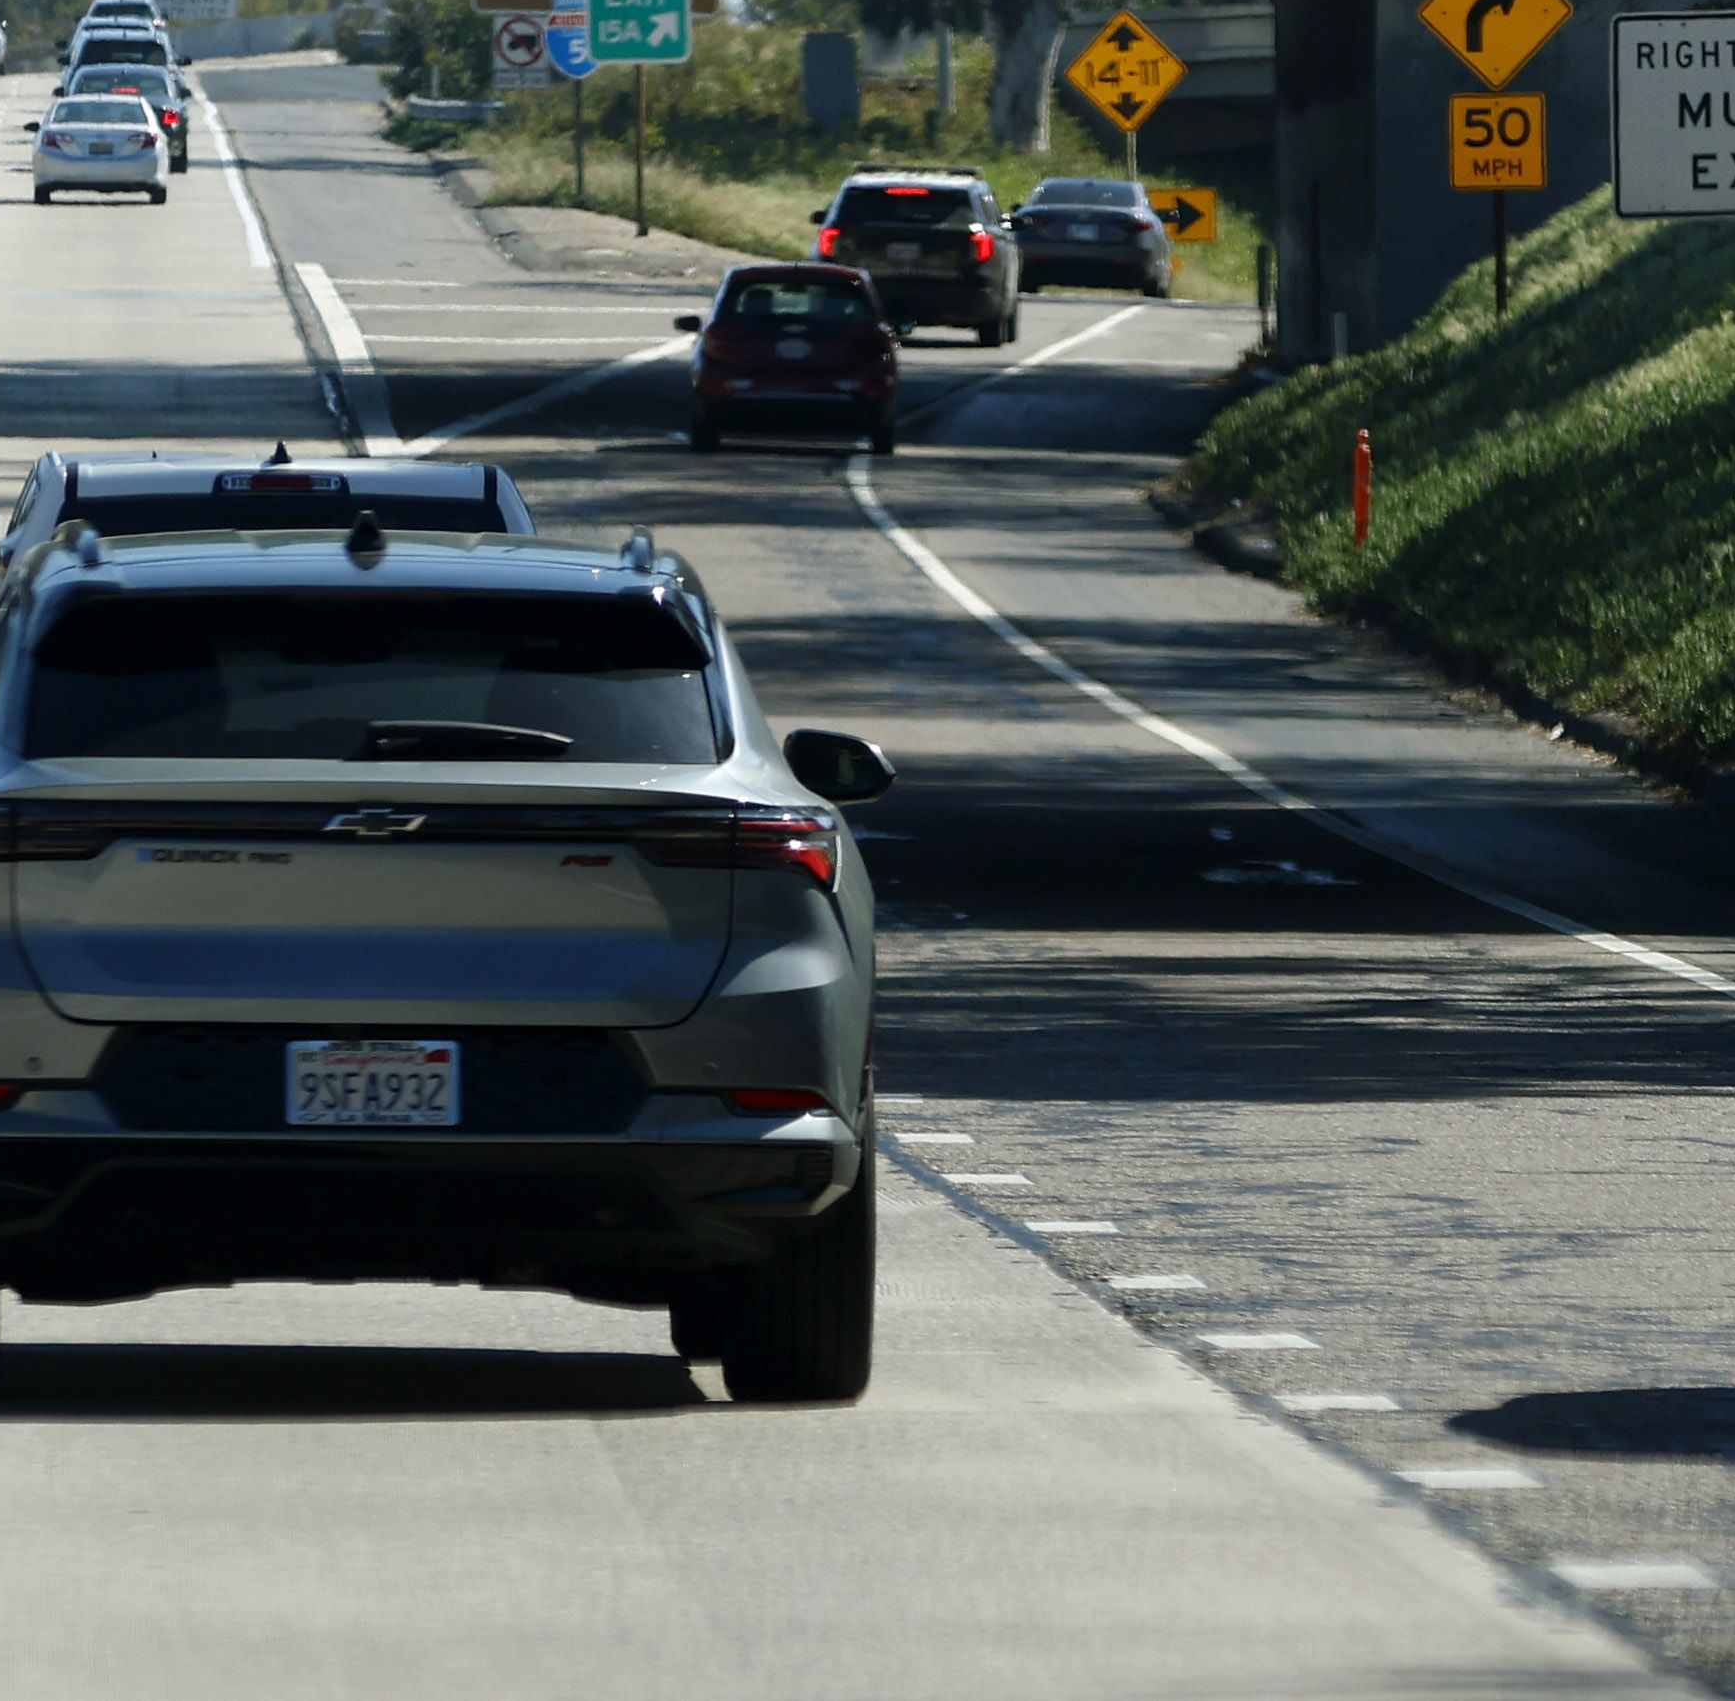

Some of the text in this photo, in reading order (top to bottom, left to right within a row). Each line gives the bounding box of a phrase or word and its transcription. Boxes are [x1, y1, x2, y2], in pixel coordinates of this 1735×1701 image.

[598, 19, 642, 44] 15A
[568, 39, 586, 64] 5
[1464, 106, 1531, 148] 50
[1473, 158, 1523, 176] MPH
[137, 849, 240, 863] QUINOX
[300, 1072, 445, 1110] 9SFA932
